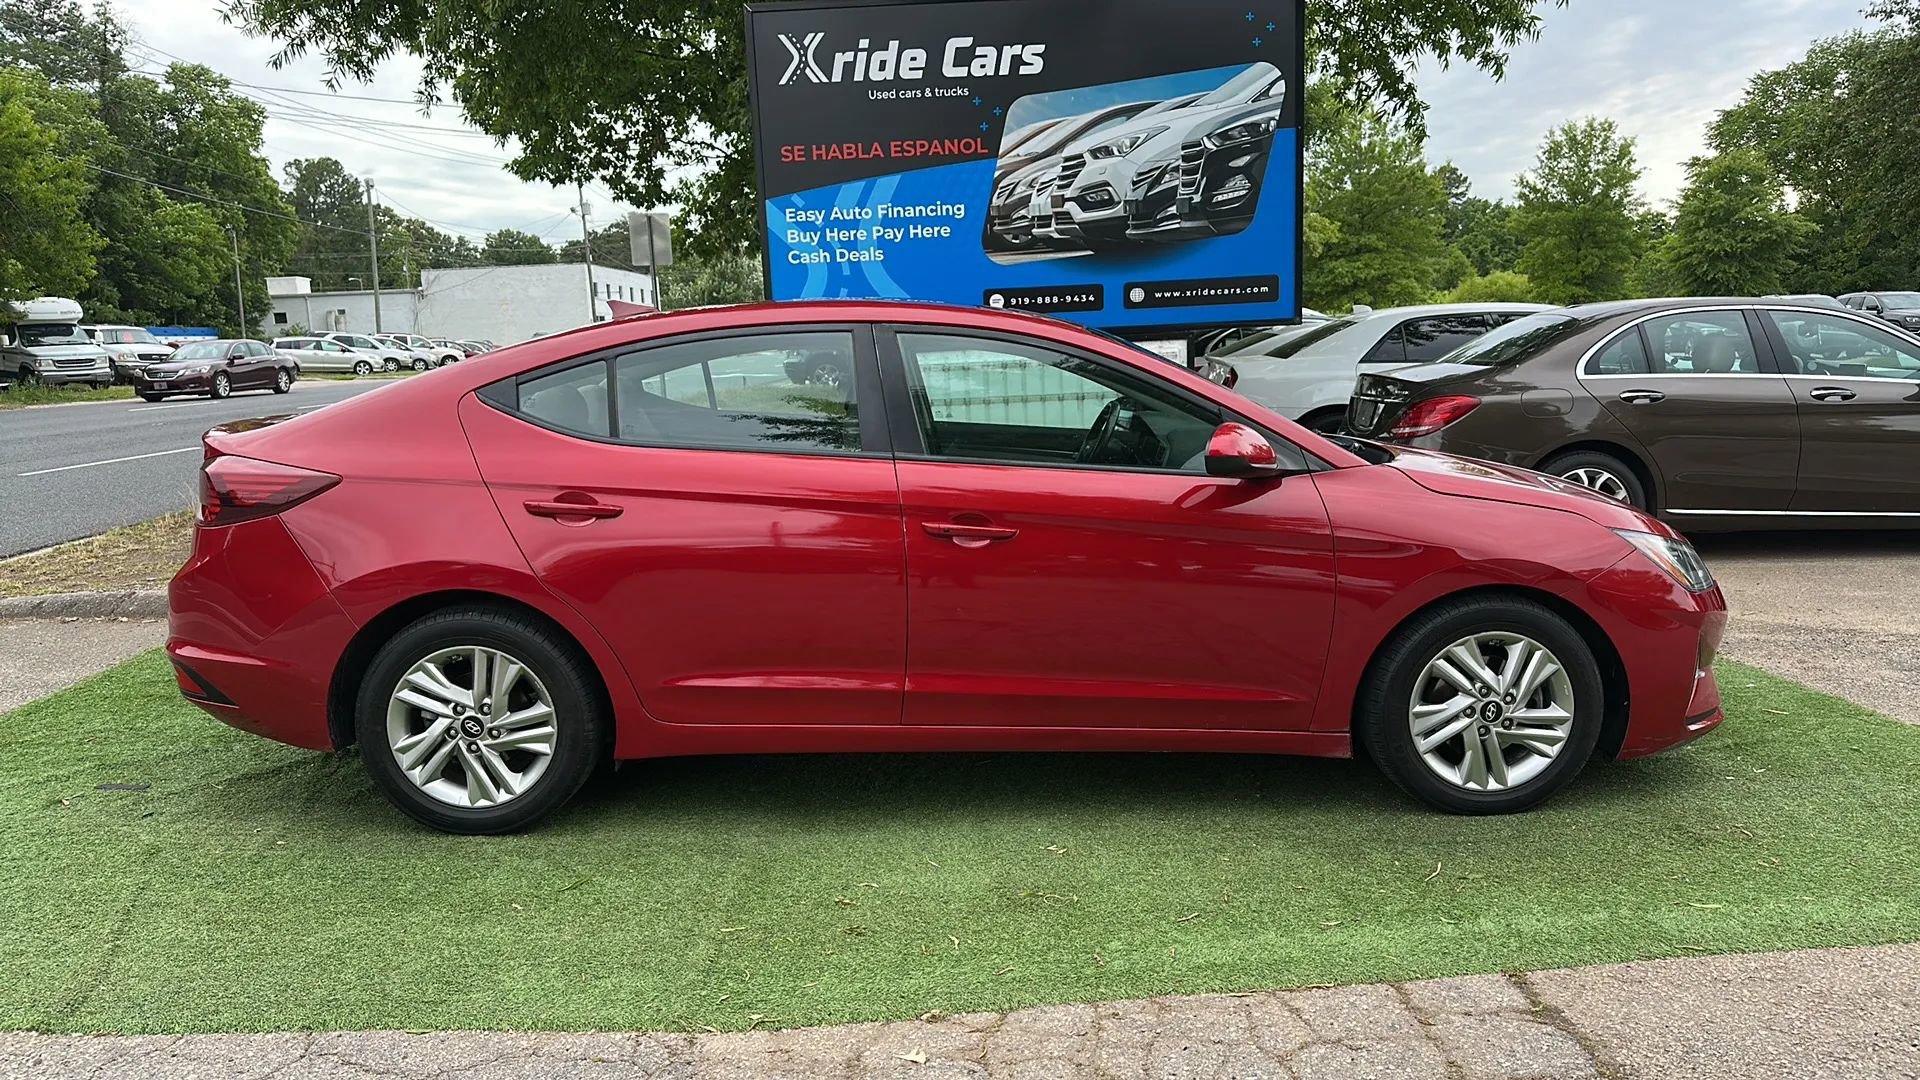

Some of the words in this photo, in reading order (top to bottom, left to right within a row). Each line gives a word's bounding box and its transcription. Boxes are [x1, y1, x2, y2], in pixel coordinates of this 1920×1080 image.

[941, 36, 1046, 78] Cars
[868, 89, 897, 101] Used
[898, 89, 922, 99] cars
[924, 87, 933, 98] &
[935, 86, 970, 98] trucks
[780, 145, 806, 163] SE
[812, 141, 885, 161] HABLA
[890, 137, 989, 159] ESPANOL
[785, 207, 825, 225] Easy
[830, 205, 873, 221] Auto
[878, 200, 966, 219] Financing
[787, 229, 821, 246] Buy
[826, 226, 868, 242] Here
[873, 225, 905, 243] Pay
[909, 223, 951, 239] Here
[787, 249, 831, 265] Cash
[836, 247, 884, 263] Deals
[1010, 294, 1095, 306] 919-888-9434
[1154, 286, 1269, 298] www.xridecars.com
